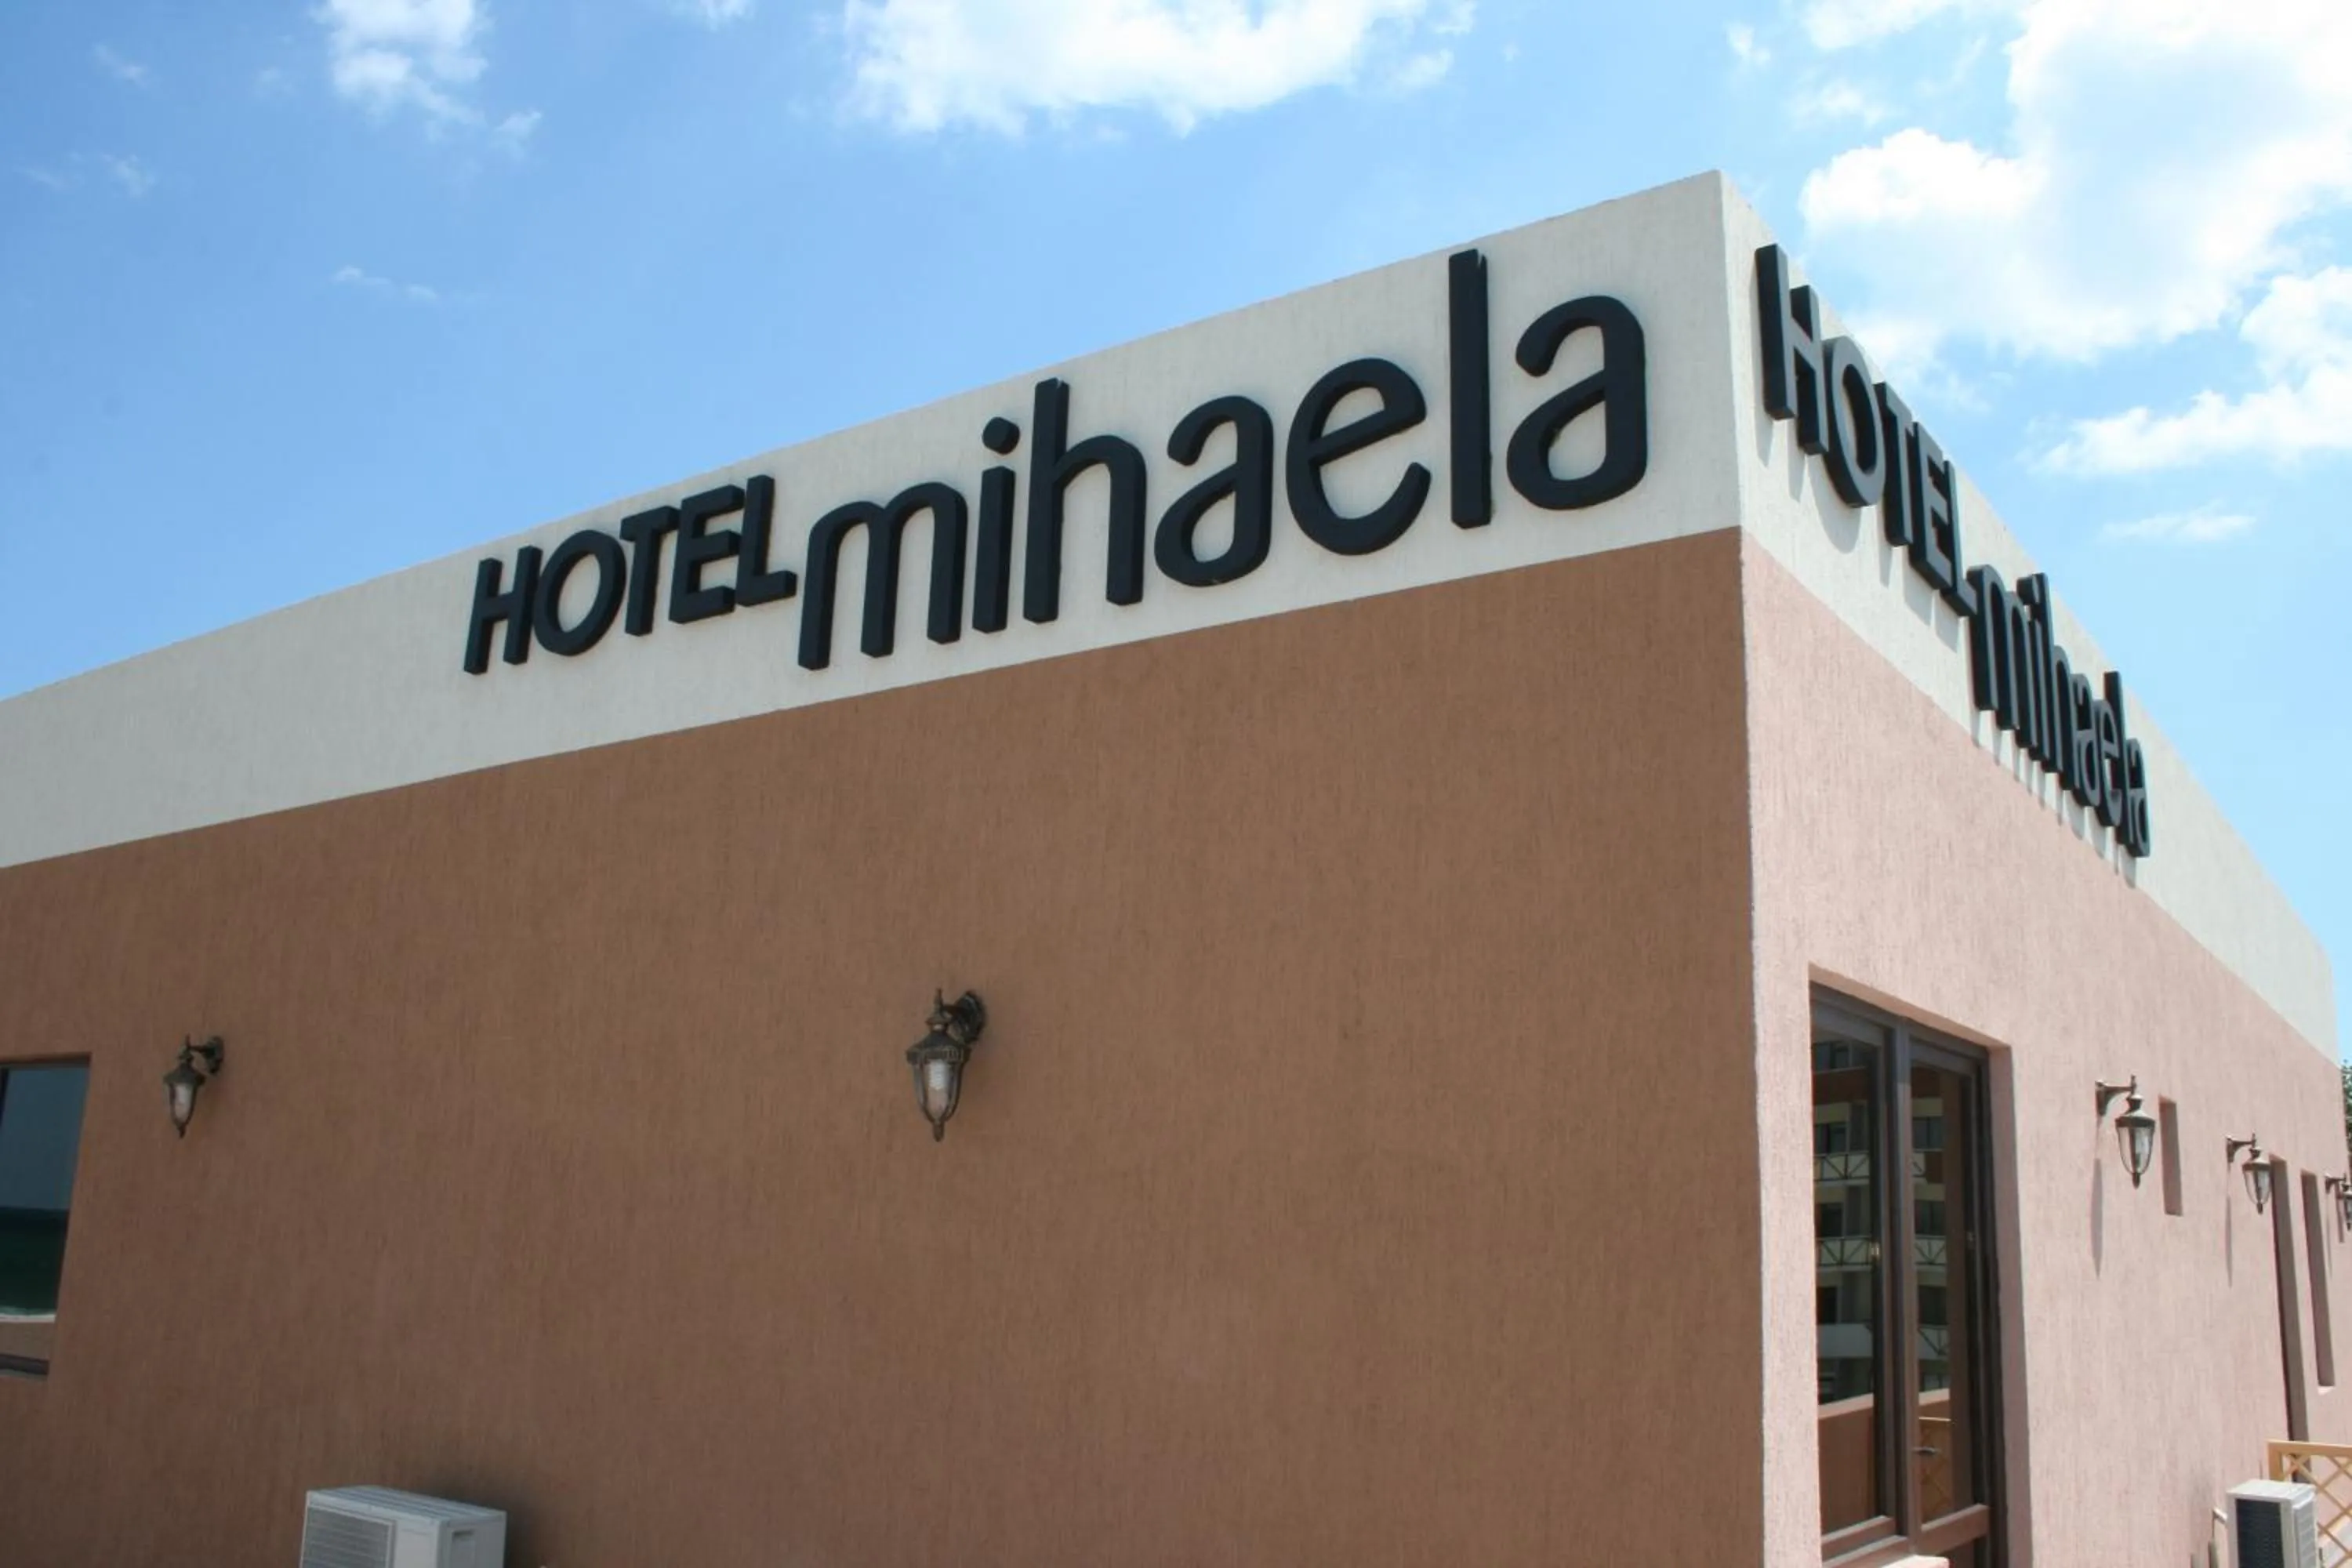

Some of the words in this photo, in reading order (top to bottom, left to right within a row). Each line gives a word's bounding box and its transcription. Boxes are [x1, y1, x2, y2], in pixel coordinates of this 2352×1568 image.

[463, 474, 797, 674] HOTEL
[797, 248, 1648, 671] mihaela
[1755, 243, 1977, 617] HOTEL
